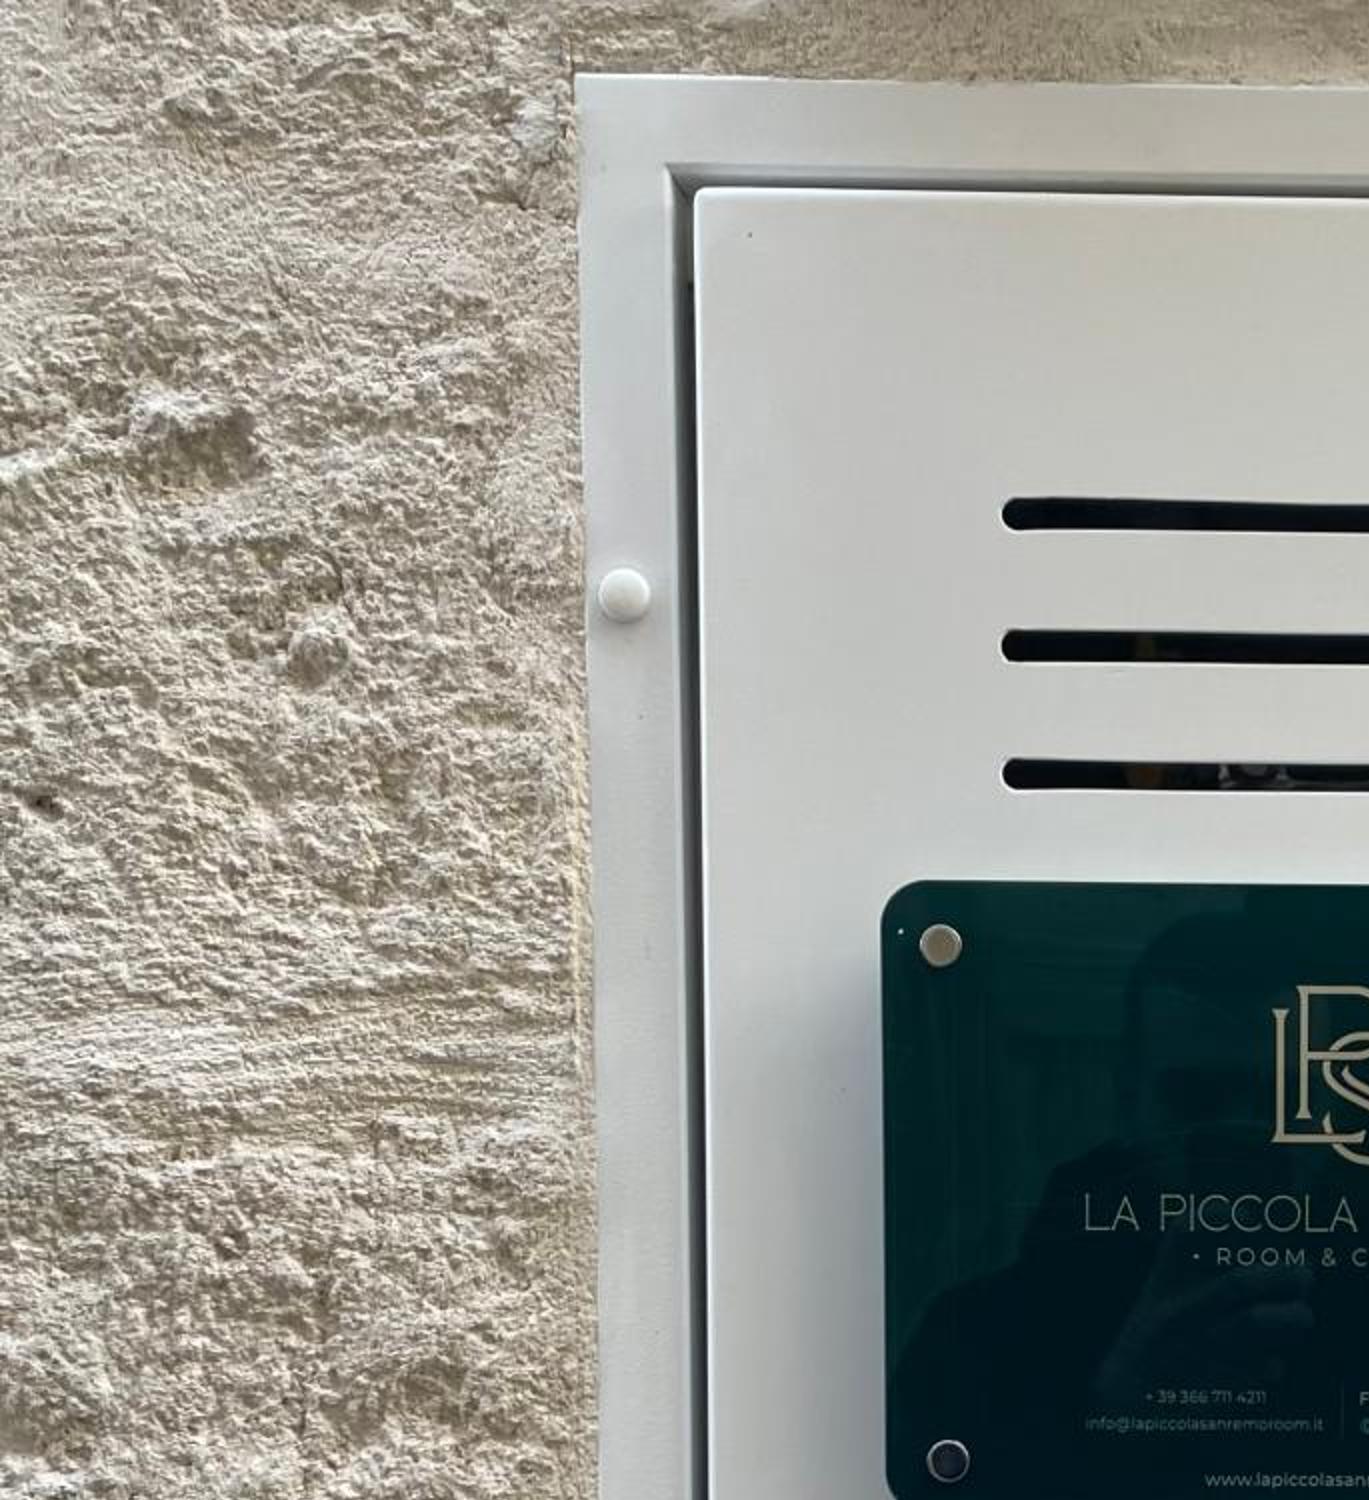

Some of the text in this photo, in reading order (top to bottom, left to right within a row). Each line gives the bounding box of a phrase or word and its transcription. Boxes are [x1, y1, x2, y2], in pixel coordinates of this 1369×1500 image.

[1084, 1193, 1140, 1231] LA
[1160, 1193, 1358, 1233] PICCOLA
[1217, 1247, 1305, 1266] ROOM
[1321, 1247, 1336, 1267] &
